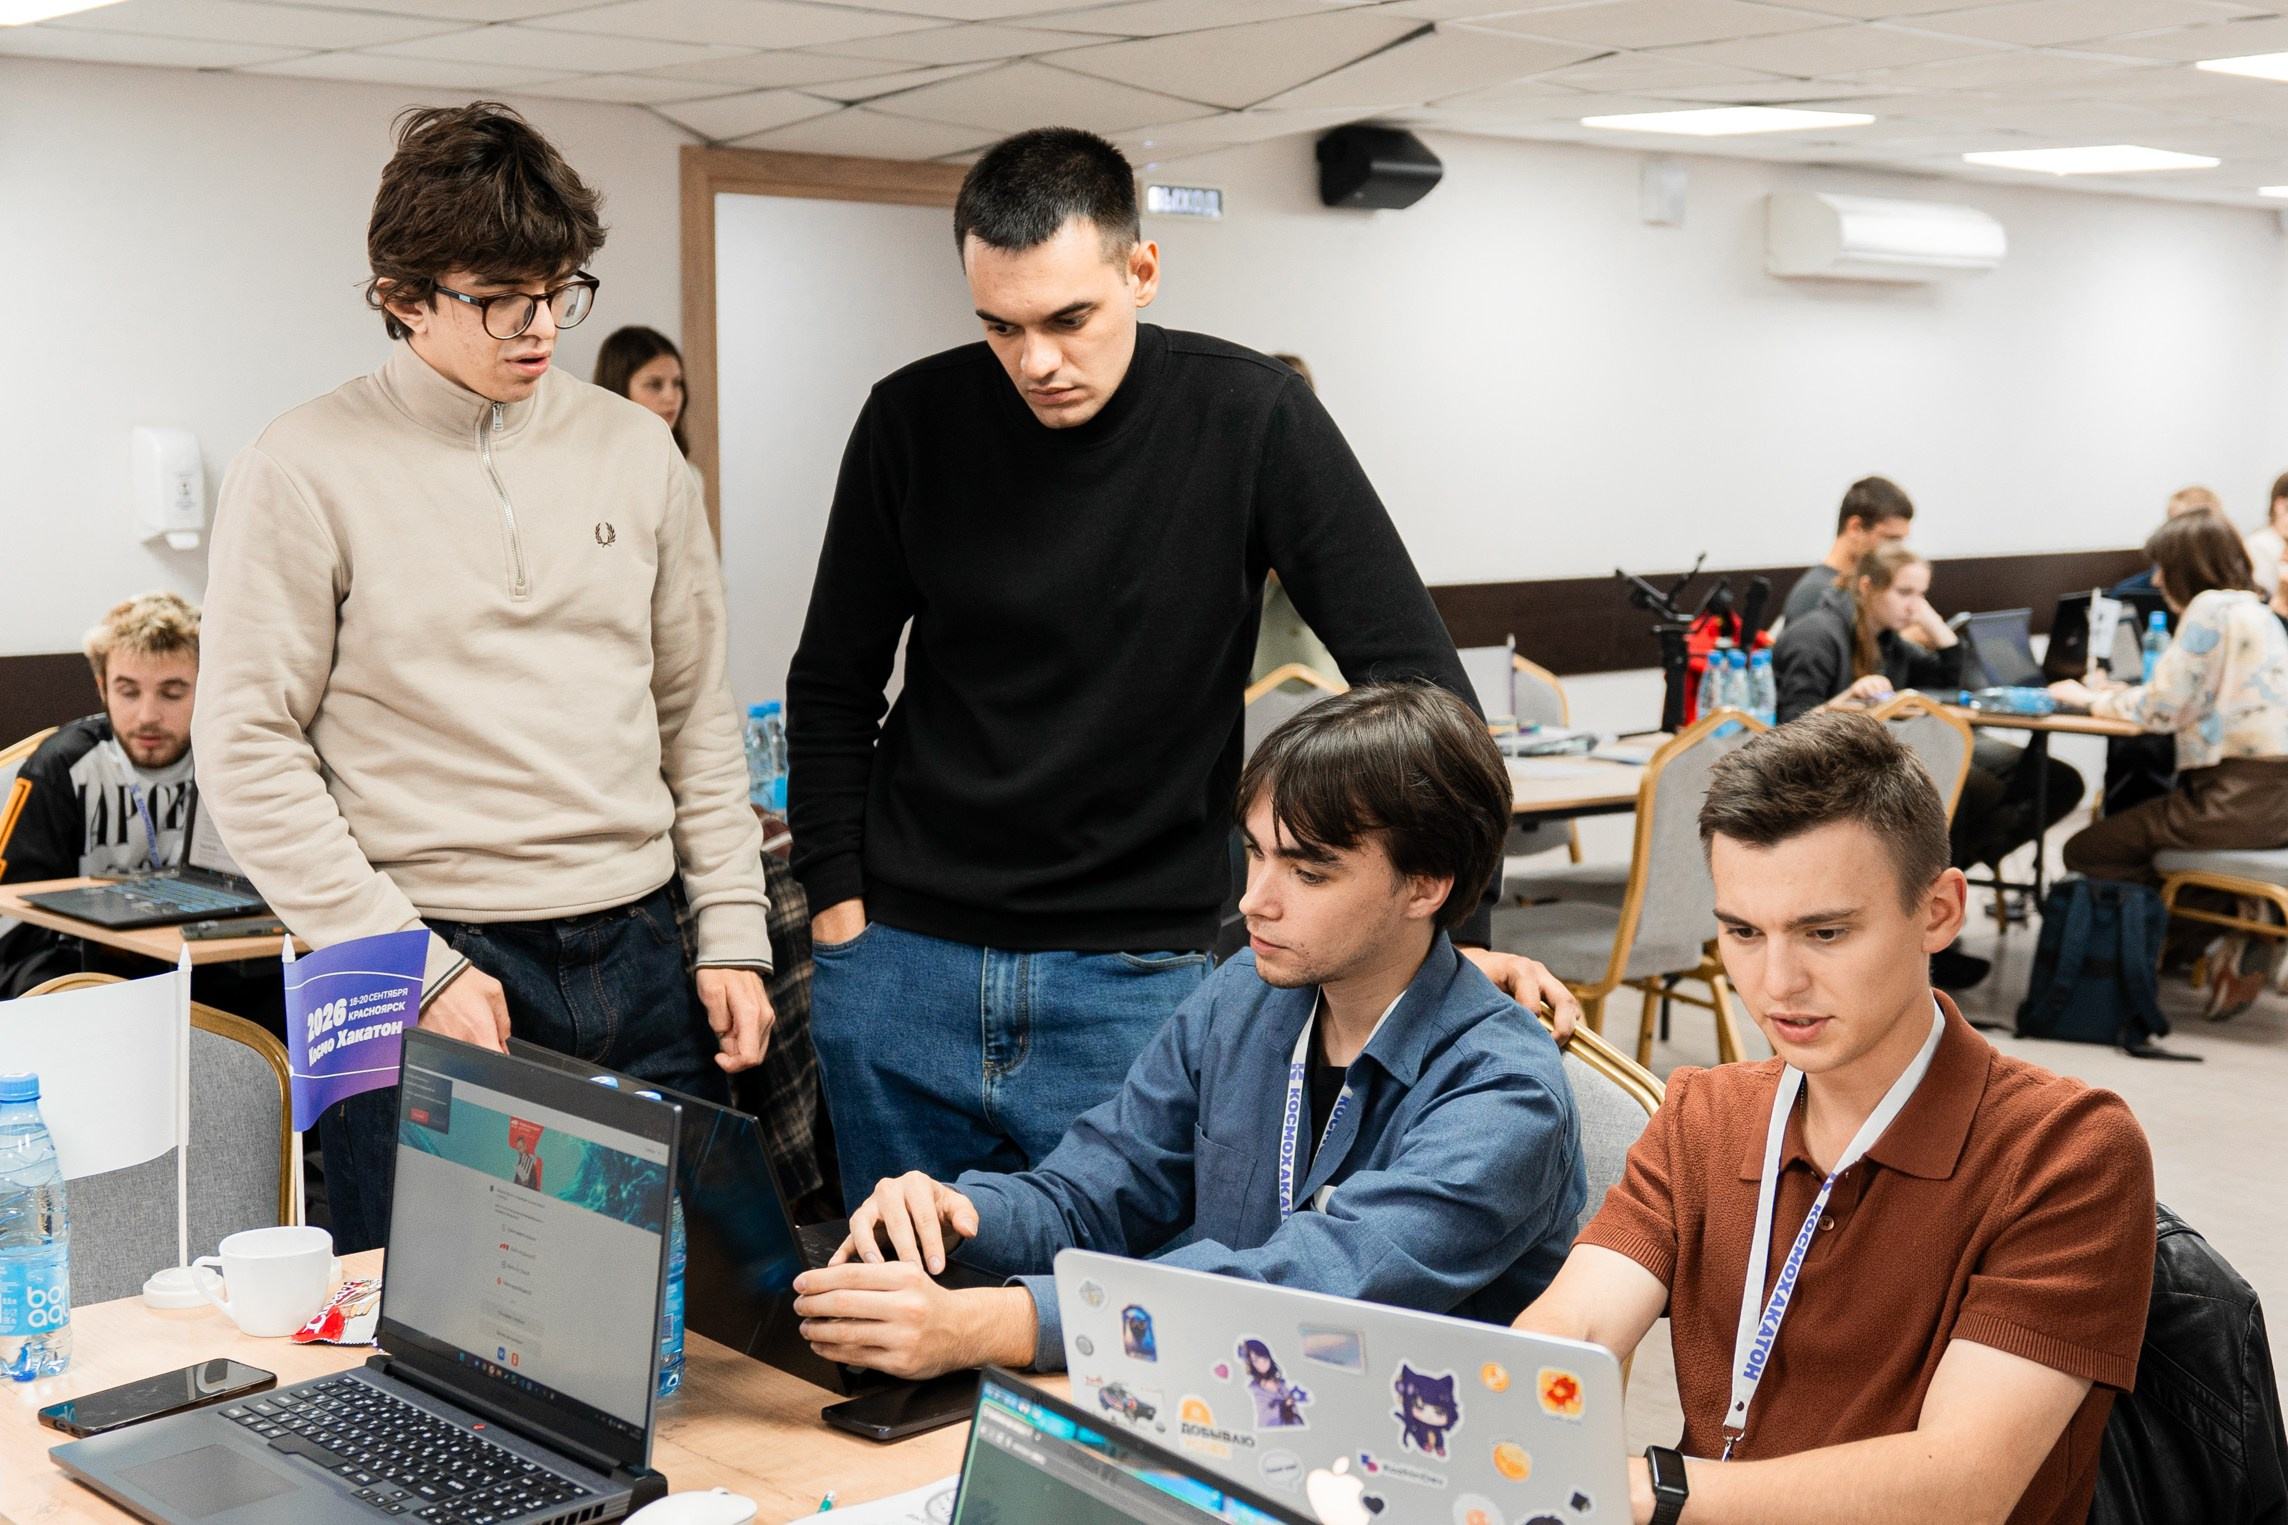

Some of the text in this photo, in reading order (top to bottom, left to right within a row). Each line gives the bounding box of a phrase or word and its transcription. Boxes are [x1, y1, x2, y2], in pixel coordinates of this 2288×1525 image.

[368, 987, 409, 1002] СЕНТЯБРЯ
[307, 998, 348, 1043] 2026
[348, 1001, 406, 1021] КРАСНОЯРСК
[1743, 1203, 1822, 1381] КОСМОХАКАТОН
